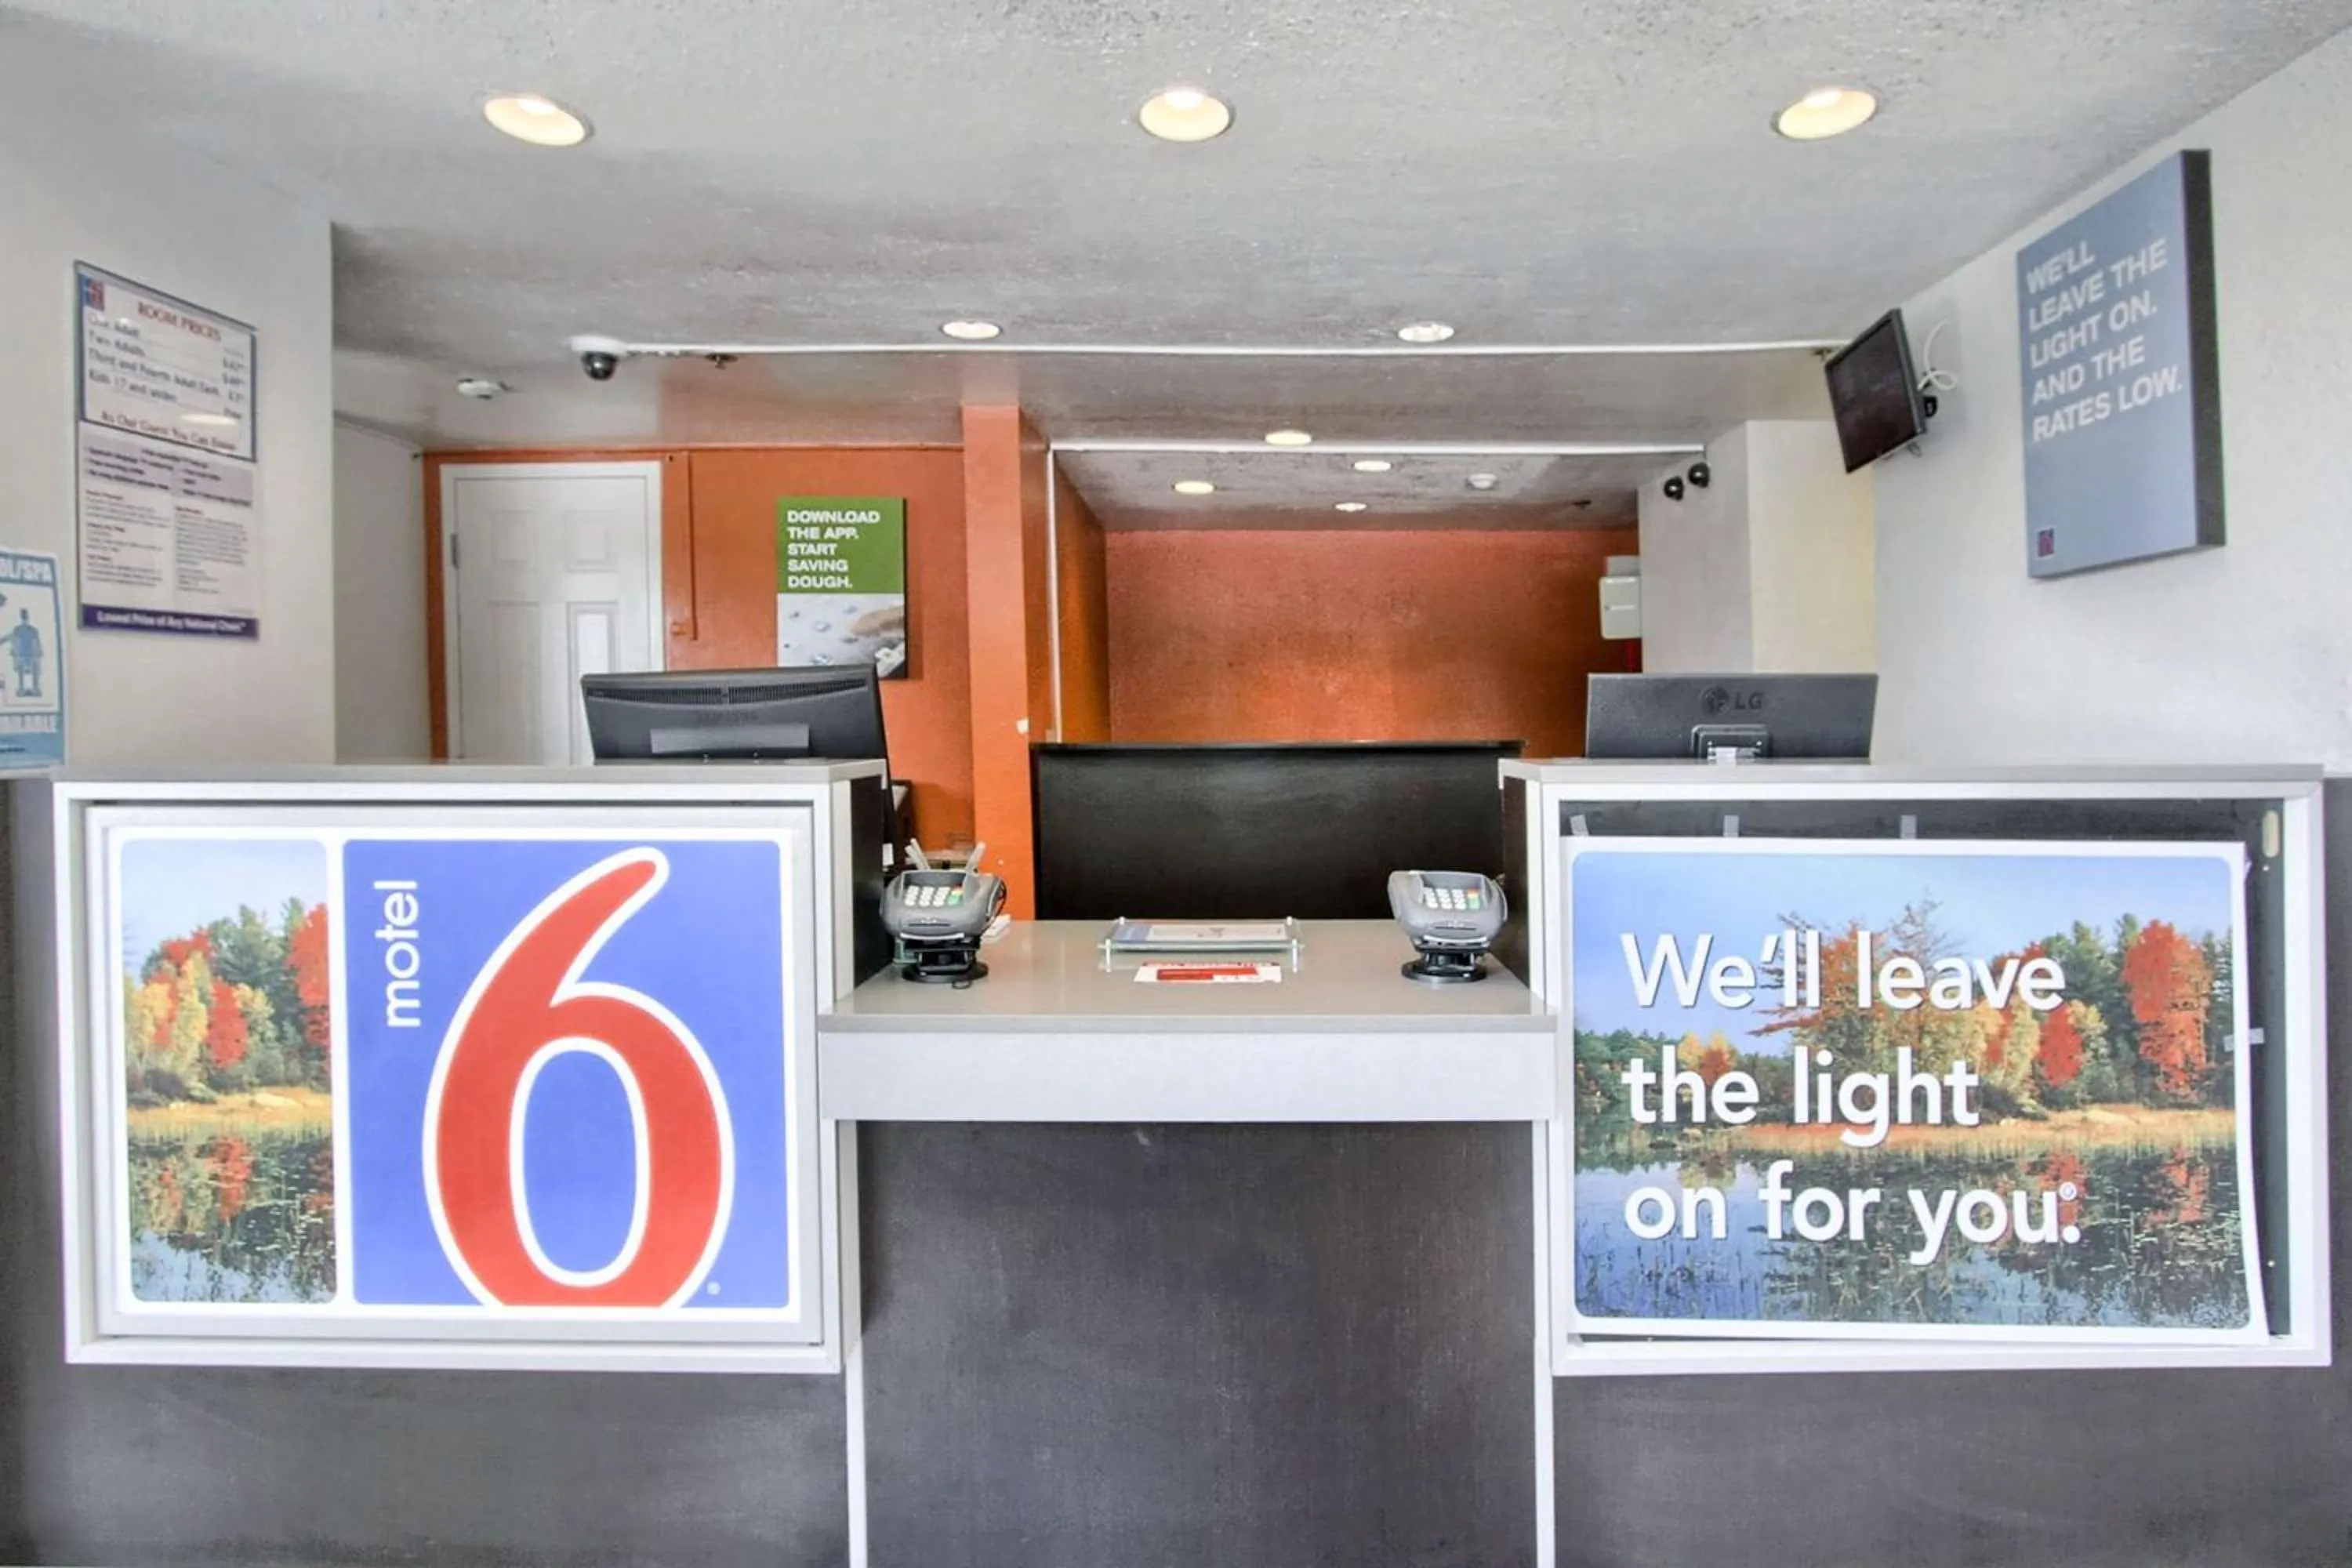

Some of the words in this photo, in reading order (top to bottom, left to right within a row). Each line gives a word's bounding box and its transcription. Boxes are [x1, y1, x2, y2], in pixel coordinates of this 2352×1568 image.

[2026, 240, 2095, 294] WE'LL
[2029, 270, 2105, 332] LEAVE
[2111, 238, 2169, 289] THE
[2030, 312, 2102, 369] LIGHT
[2109, 289, 2158, 332] ON.
[2031, 363, 2085, 405] AND
[2090, 335, 2145, 380] THE
[2033, 391, 2111, 443] RATES
[2119, 364, 2183, 412] LOW.
[787, 510, 880, 524] DOWNLOAD
[787, 543, 837, 555] START
[788, 527, 820, 539] THE
[824, 527, 859, 540] APP.
[787, 559, 848, 572] SAVING
[787, 575, 853, 588] DOUGH.
[1735, 692, 1763, 710] LG
[372, 880, 421, 1029] motel
[1620, 930, 1820, 1008] We'll
[1857, 931, 2067, 1011] leave
[422, 846, 735, 1308] 6
[1621, 1044, 1760, 1125] the
[1794, 1045, 1980, 1148] light
[1624, 1182, 1727, 1240] on
[1758, 1160, 1881, 1241] for
